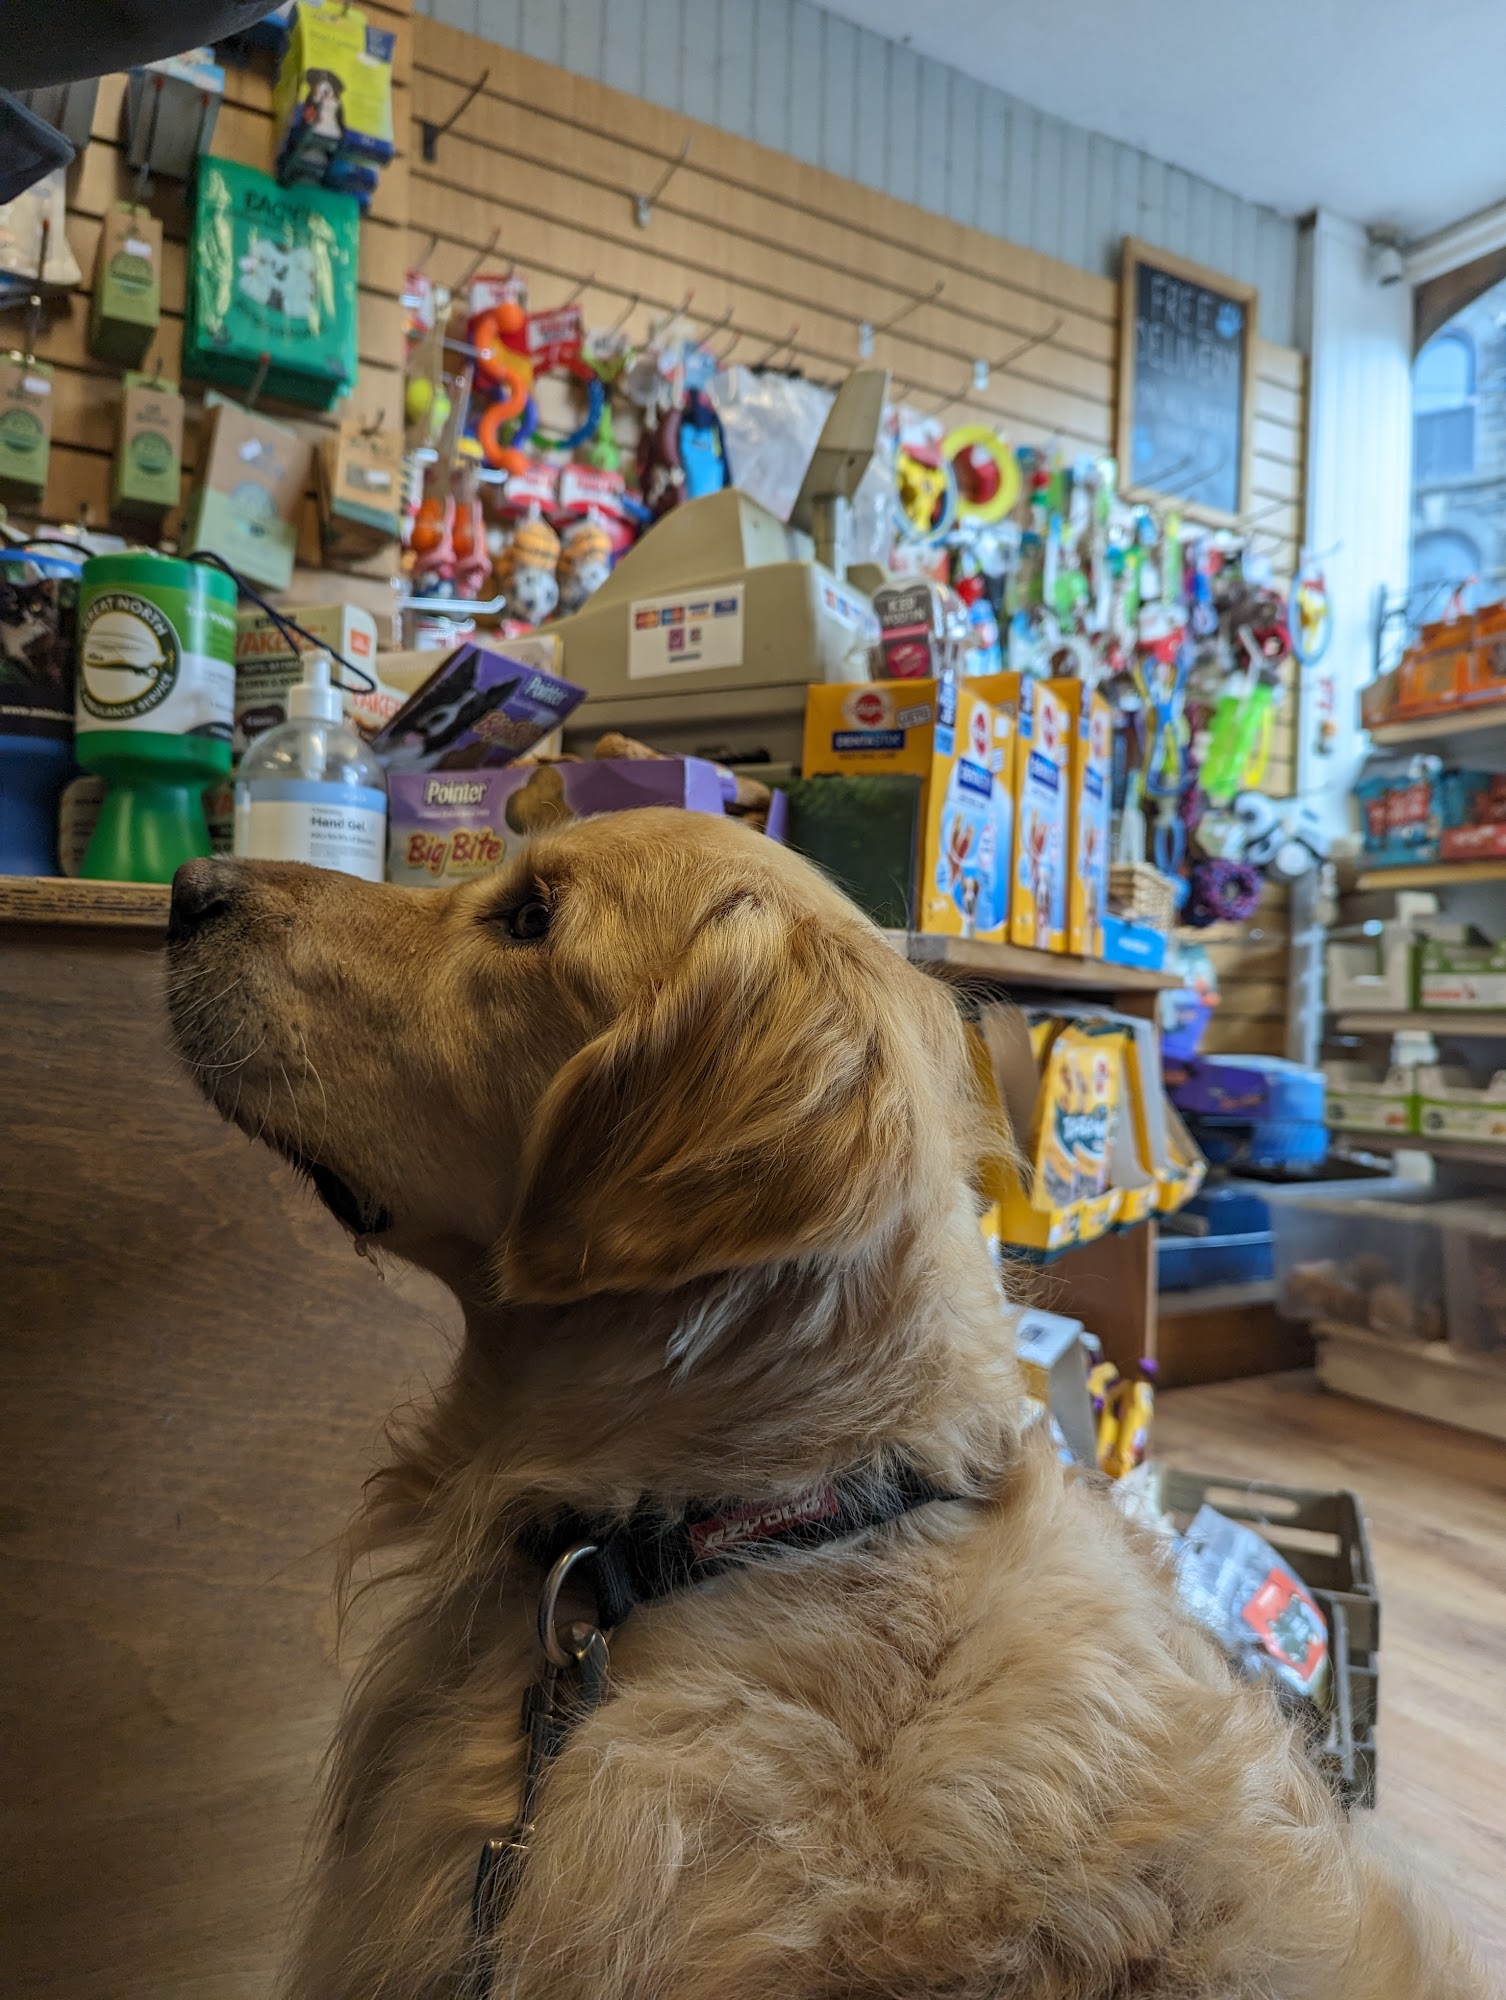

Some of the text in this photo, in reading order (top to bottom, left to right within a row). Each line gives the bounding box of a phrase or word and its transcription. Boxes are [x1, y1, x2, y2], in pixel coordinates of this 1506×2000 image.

[1151, 273, 1214, 345] FREE
[117, 597, 169, 636] NORTH
[427, 779, 488, 805] Pointer
[311, 815, 366, 832] Hand Gel
[408, 828, 502, 874] Big Bite
